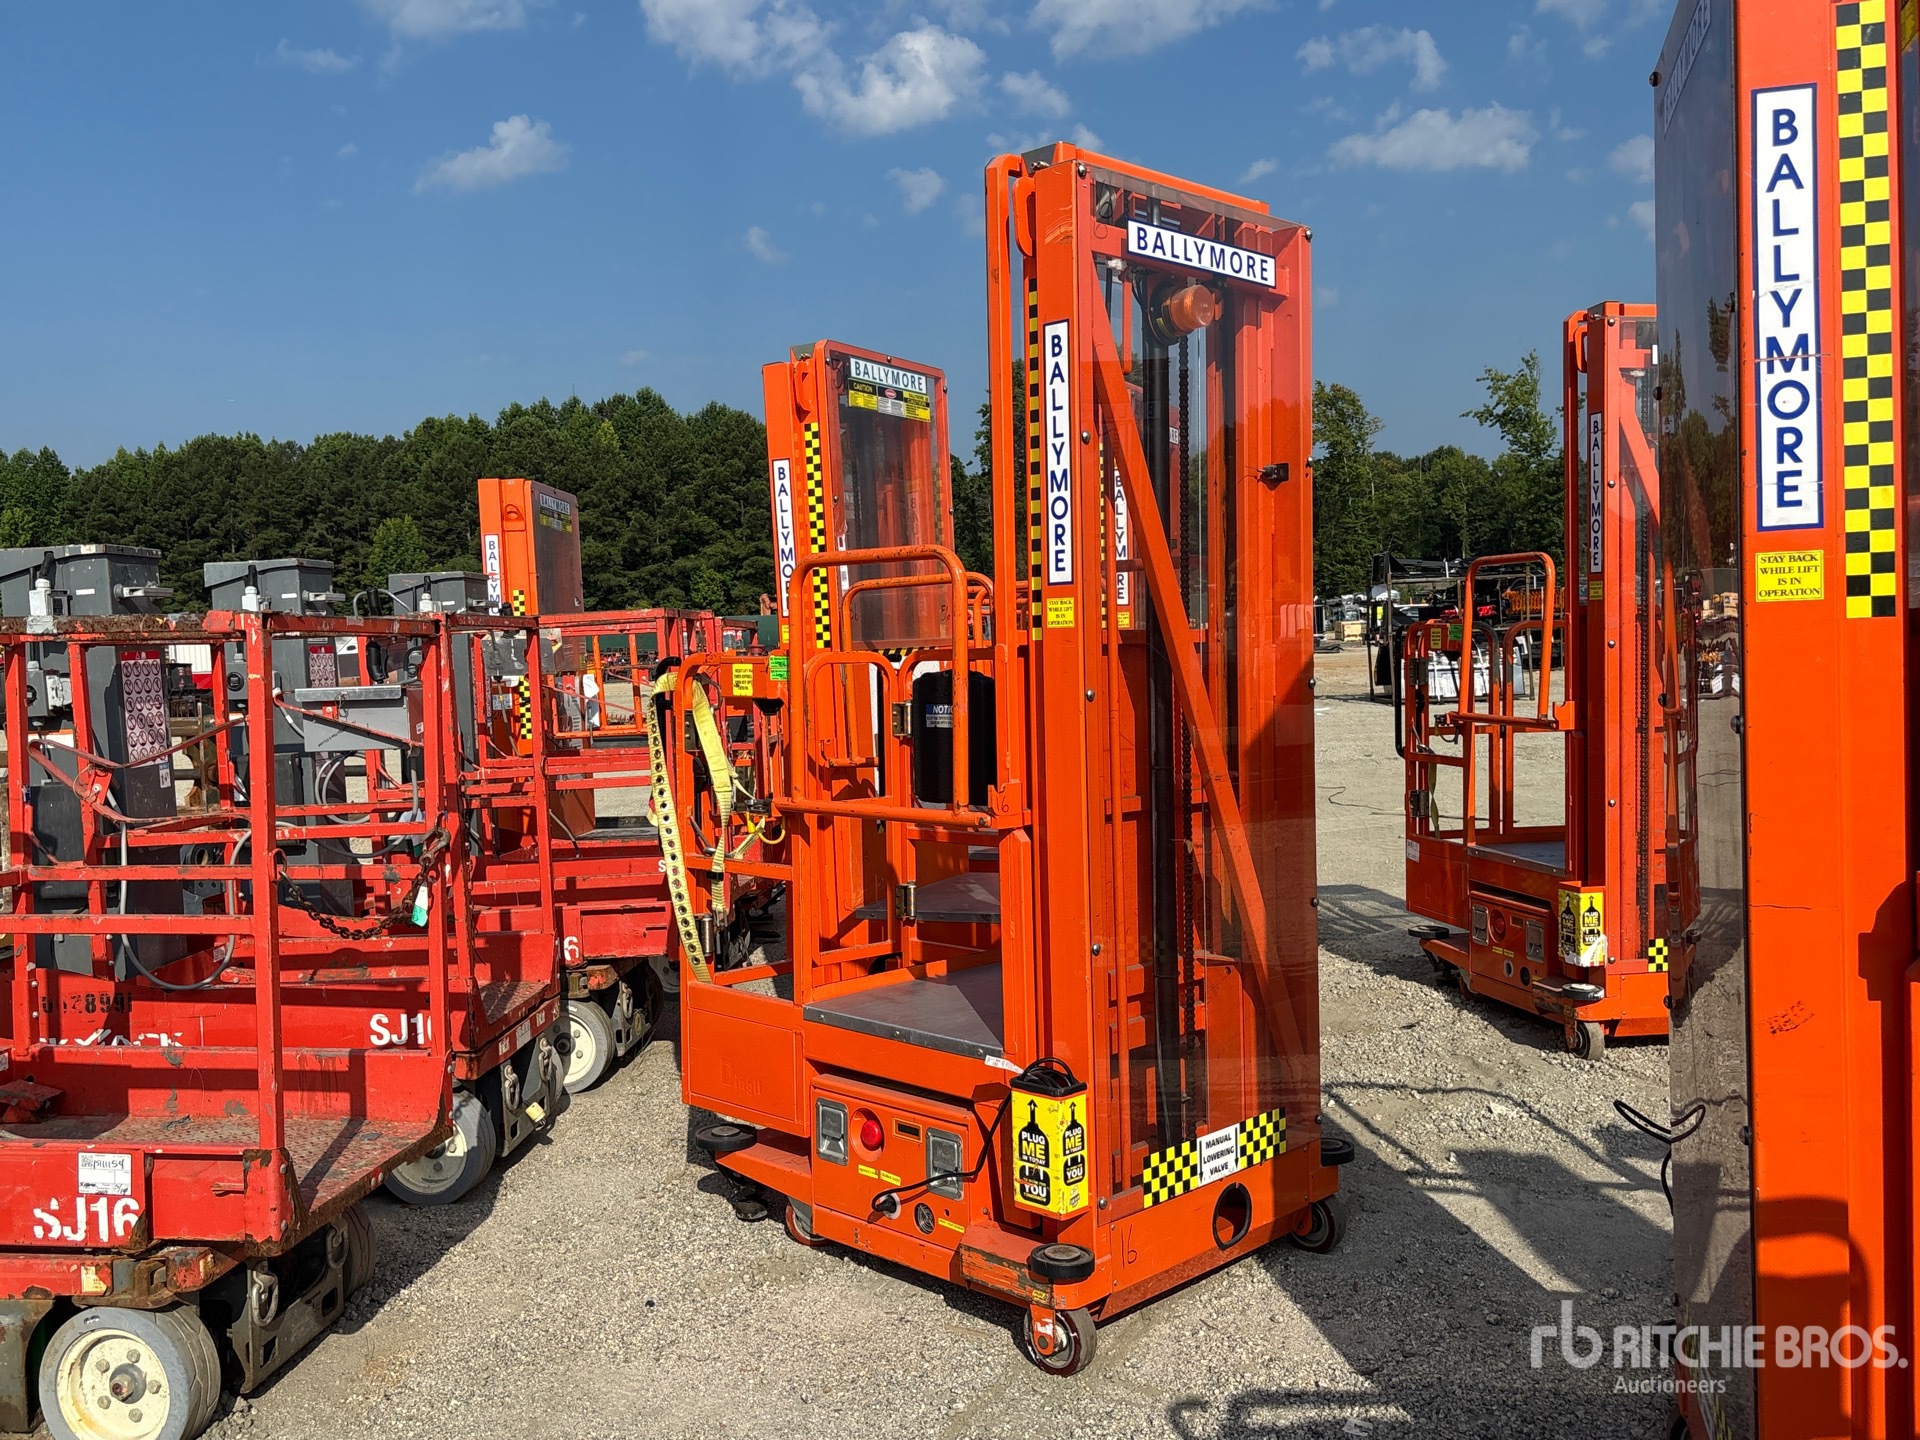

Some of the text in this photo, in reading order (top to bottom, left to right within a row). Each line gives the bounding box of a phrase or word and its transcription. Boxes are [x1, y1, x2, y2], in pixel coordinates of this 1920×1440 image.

[1137, 226, 1269, 282] BALLYMORE
[1766, 108, 1810, 509] BALLYMORE
[854, 360, 924, 392] BALLYMORE
[1049, 334, 1069, 572] BALLYMORE
[1592, 420, 1601, 566] BALLYMORE
[777, 467, 794, 610] BALLYMO
[1114, 475, 1127, 600] BALLYMRE
[1760, 554, 1818, 564] STAY BACK
[1760, 565, 1820, 575] WHILE LIFT
[1777, 577, 1801, 585] IS IN
[1759, 587, 1820, 597] OPERATION
[933, 704, 953, 714] NOTI
[1021, 1131, 1046, 1145] PLUG
[1064, 1127, 1082, 1138] PLUG
[1065, 1134, 1082, 1149] ME
[1205, 1133, 1232, 1149] MANUAL
[1022, 1141, 1046, 1160] ME
[1203, 1146, 1235, 1164] LOWERING
[1066, 1167, 1083, 1180] YOU
[1209, 1161, 1229, 1176] VALVE
[1024, 1184, 1047, 1197] YOU
[33, 1197, 140, 1243] SJ16
